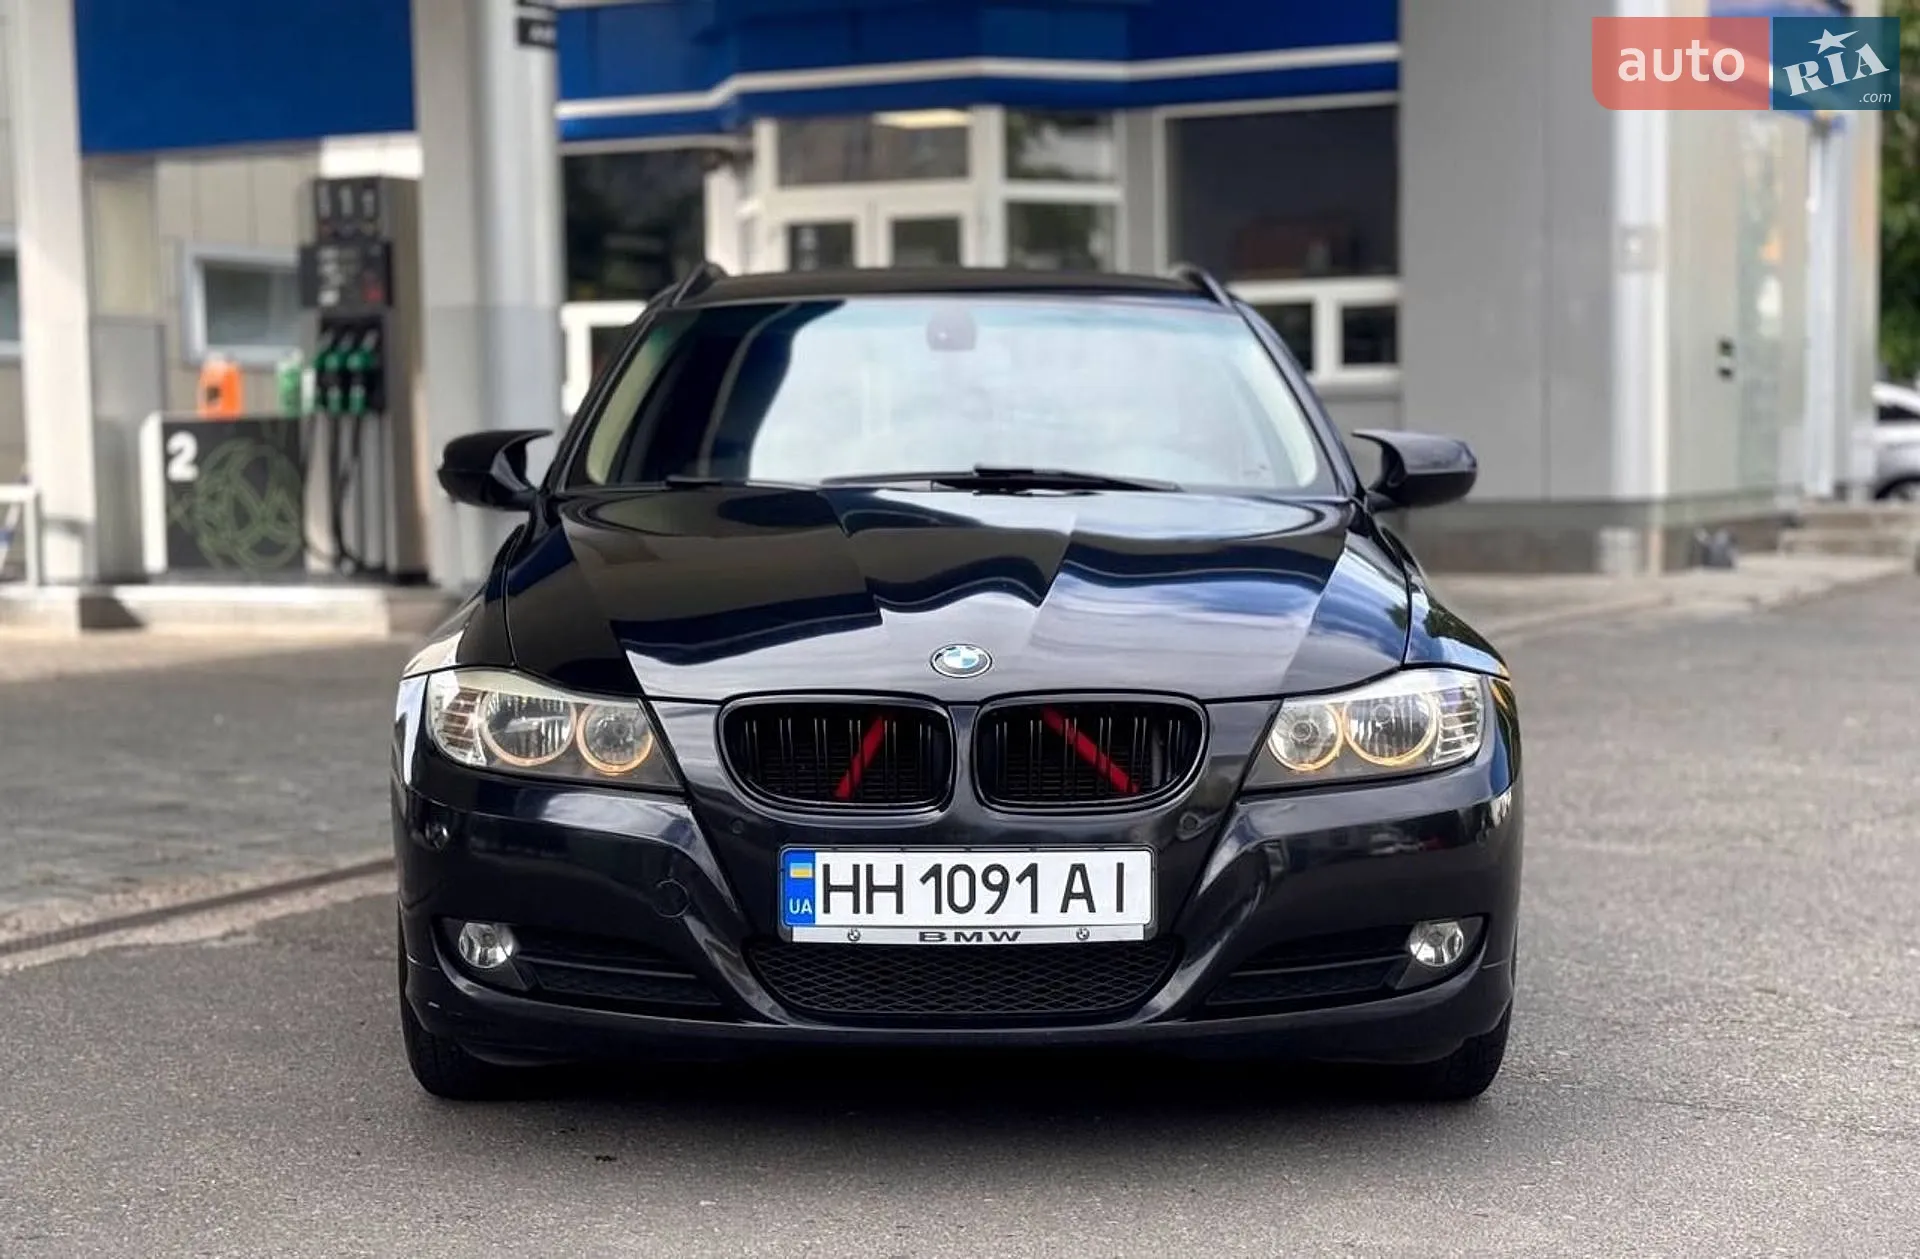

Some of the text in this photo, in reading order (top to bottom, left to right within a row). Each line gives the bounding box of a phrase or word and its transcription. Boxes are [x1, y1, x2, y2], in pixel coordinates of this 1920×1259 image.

[167, 430, 199, 482] 2
[821, 863, 902, 915] HH
[919, 862, 1038, 915] 1091
[788, 898, 813, 915] UA
[918, 930, 1022, 944] BMW
